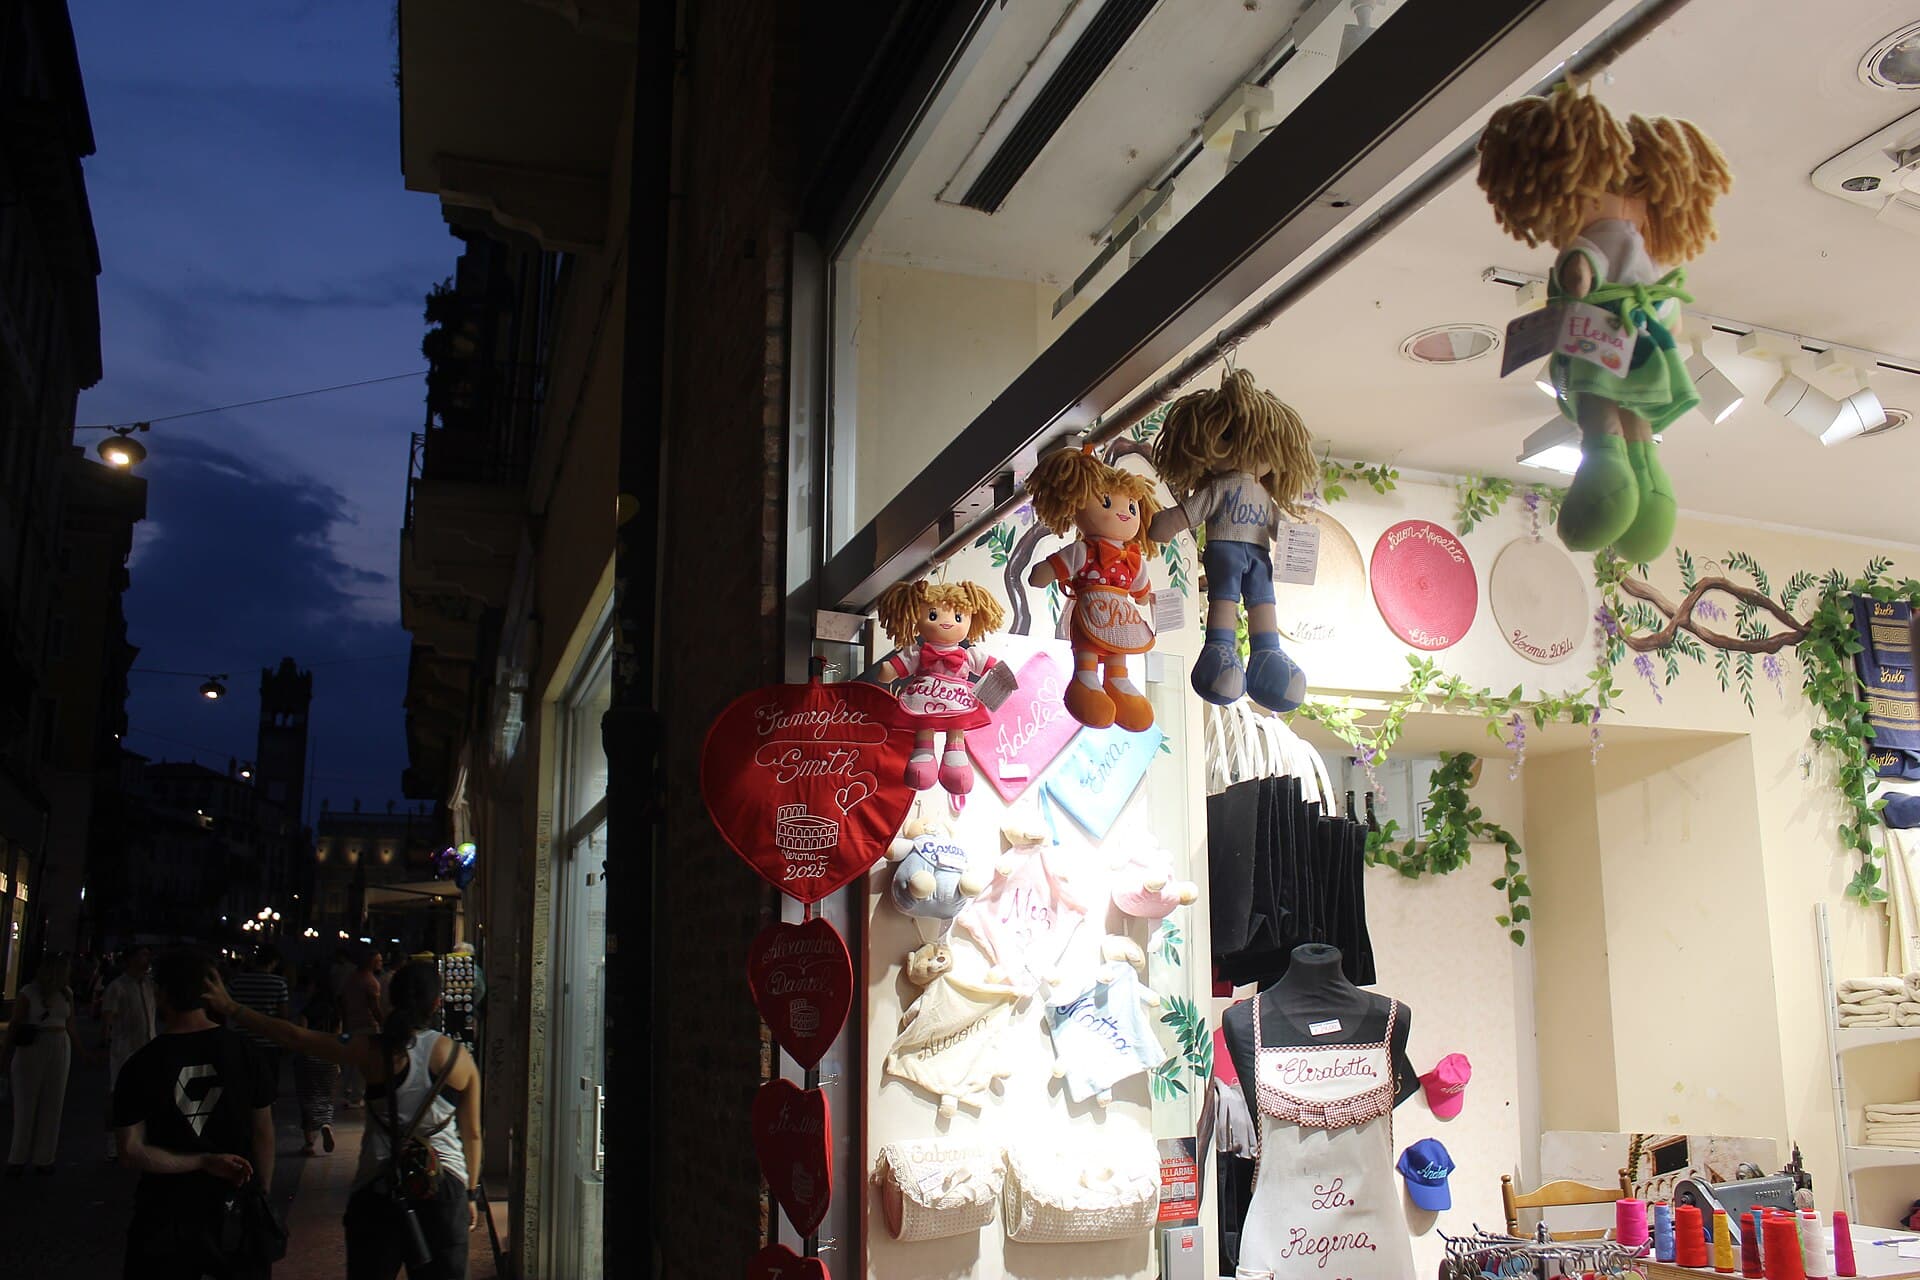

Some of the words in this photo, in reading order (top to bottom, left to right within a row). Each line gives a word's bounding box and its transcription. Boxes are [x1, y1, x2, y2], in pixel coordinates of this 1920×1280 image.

[1568, 316, 1625, 351] Elena
[1387, 526, 1417, 552] Buon
[1420, 525, 1466, 564] Appetito
[1512, 629, 1548, 660] Verona
[1549, 637, 1574, 659] 2024
[754, 700, 870, 740] Famiglia
[996, 700, 1064, 767] Adele
[775, 747, 861, 785] Smith
[781, 849, 826, 862] Verona
[783, 861, 829, 881] 2025
[917, 1016, 990, 1062] Aurora
[1276, 1056, 1378, 1085] Elisabetta
[1312, 1177, 1355, 1210] La
[1281, 1227, 1377, 1268] Regina
